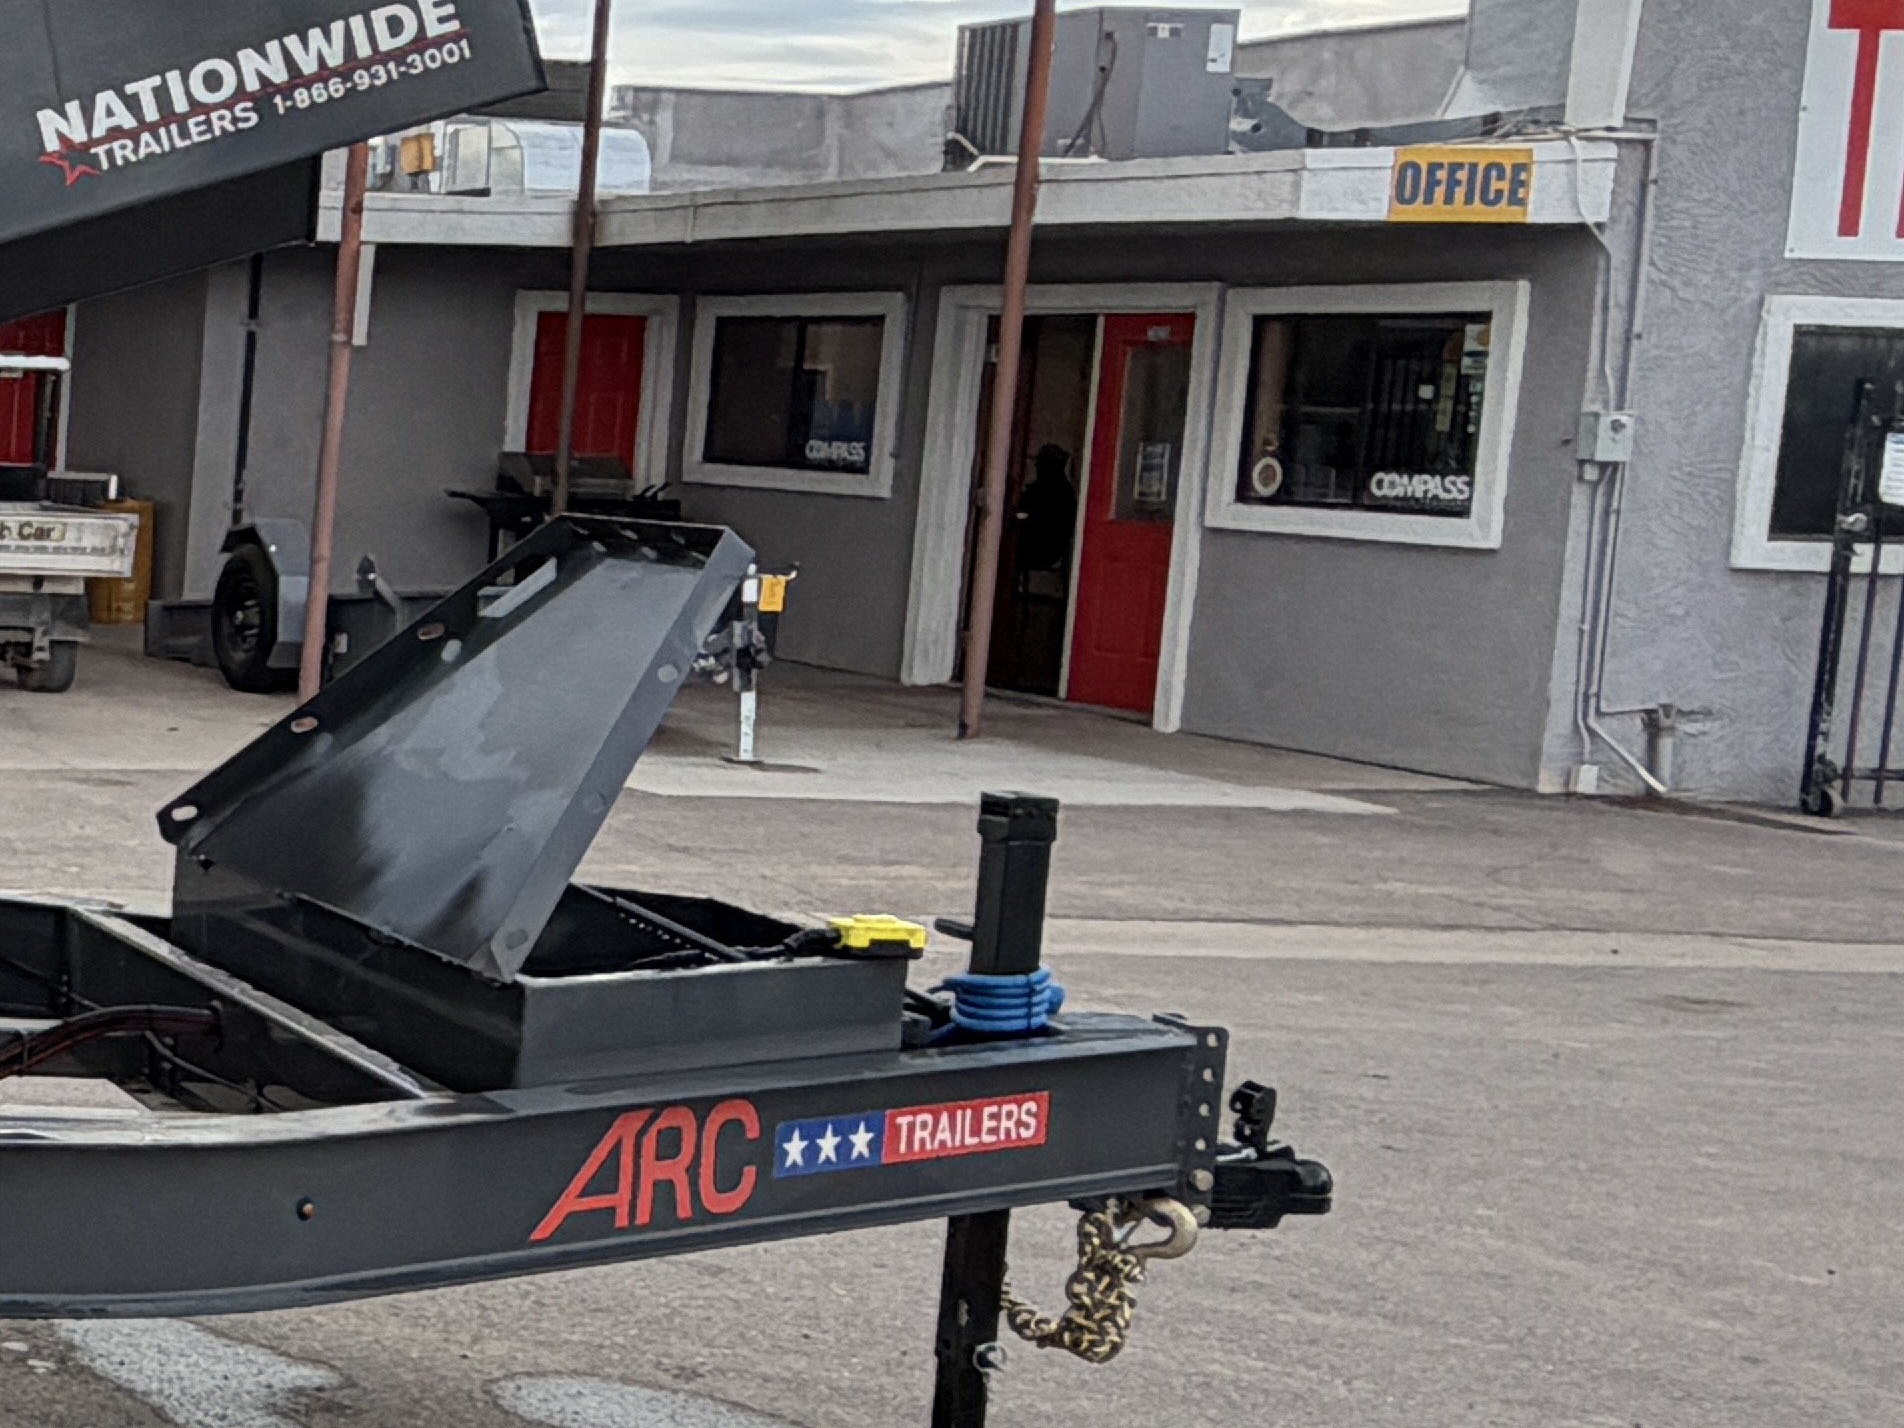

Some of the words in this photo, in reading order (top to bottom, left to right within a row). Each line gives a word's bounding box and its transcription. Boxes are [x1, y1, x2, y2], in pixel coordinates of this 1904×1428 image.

[90, 100, 259, 171] TRAILERS
[272, 38, 472, 115] 1-866-931-3001
[1395, 160, 1529, 206] OFFICE
[1371, 471, 1470, 501] COMPASS
[17, 521, 55, 541] Car
[529, 1098, 761, 1242] ARC
[895, 1100, 1039, 1153] TRAILERS
